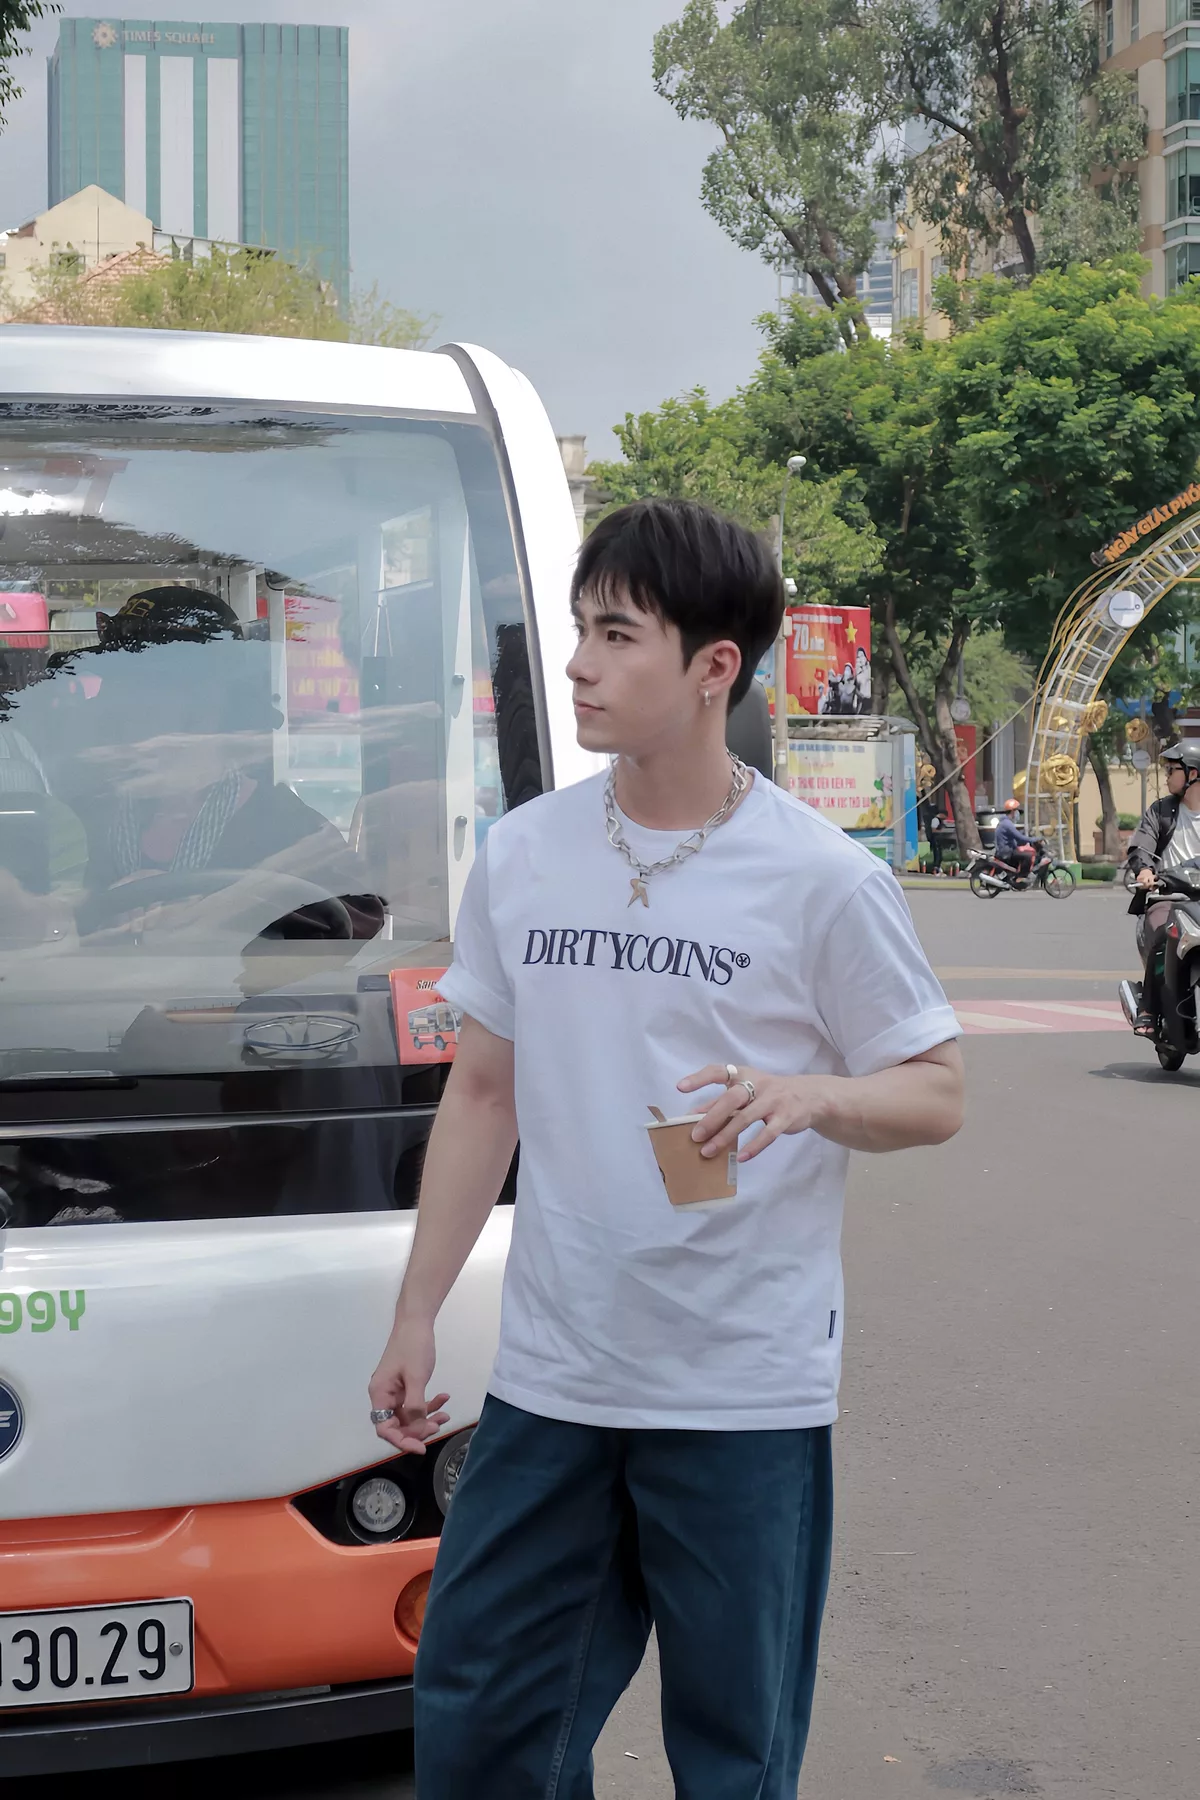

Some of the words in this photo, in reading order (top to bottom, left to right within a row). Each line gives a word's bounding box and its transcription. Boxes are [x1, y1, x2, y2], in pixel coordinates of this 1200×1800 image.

[122, 30, 161, 41] TIMES
[793, 623, 809, 651] 70
[522, 929, 737, 985] DIRTYCOINS
[0, 1618, 166, 1692] 30.29
